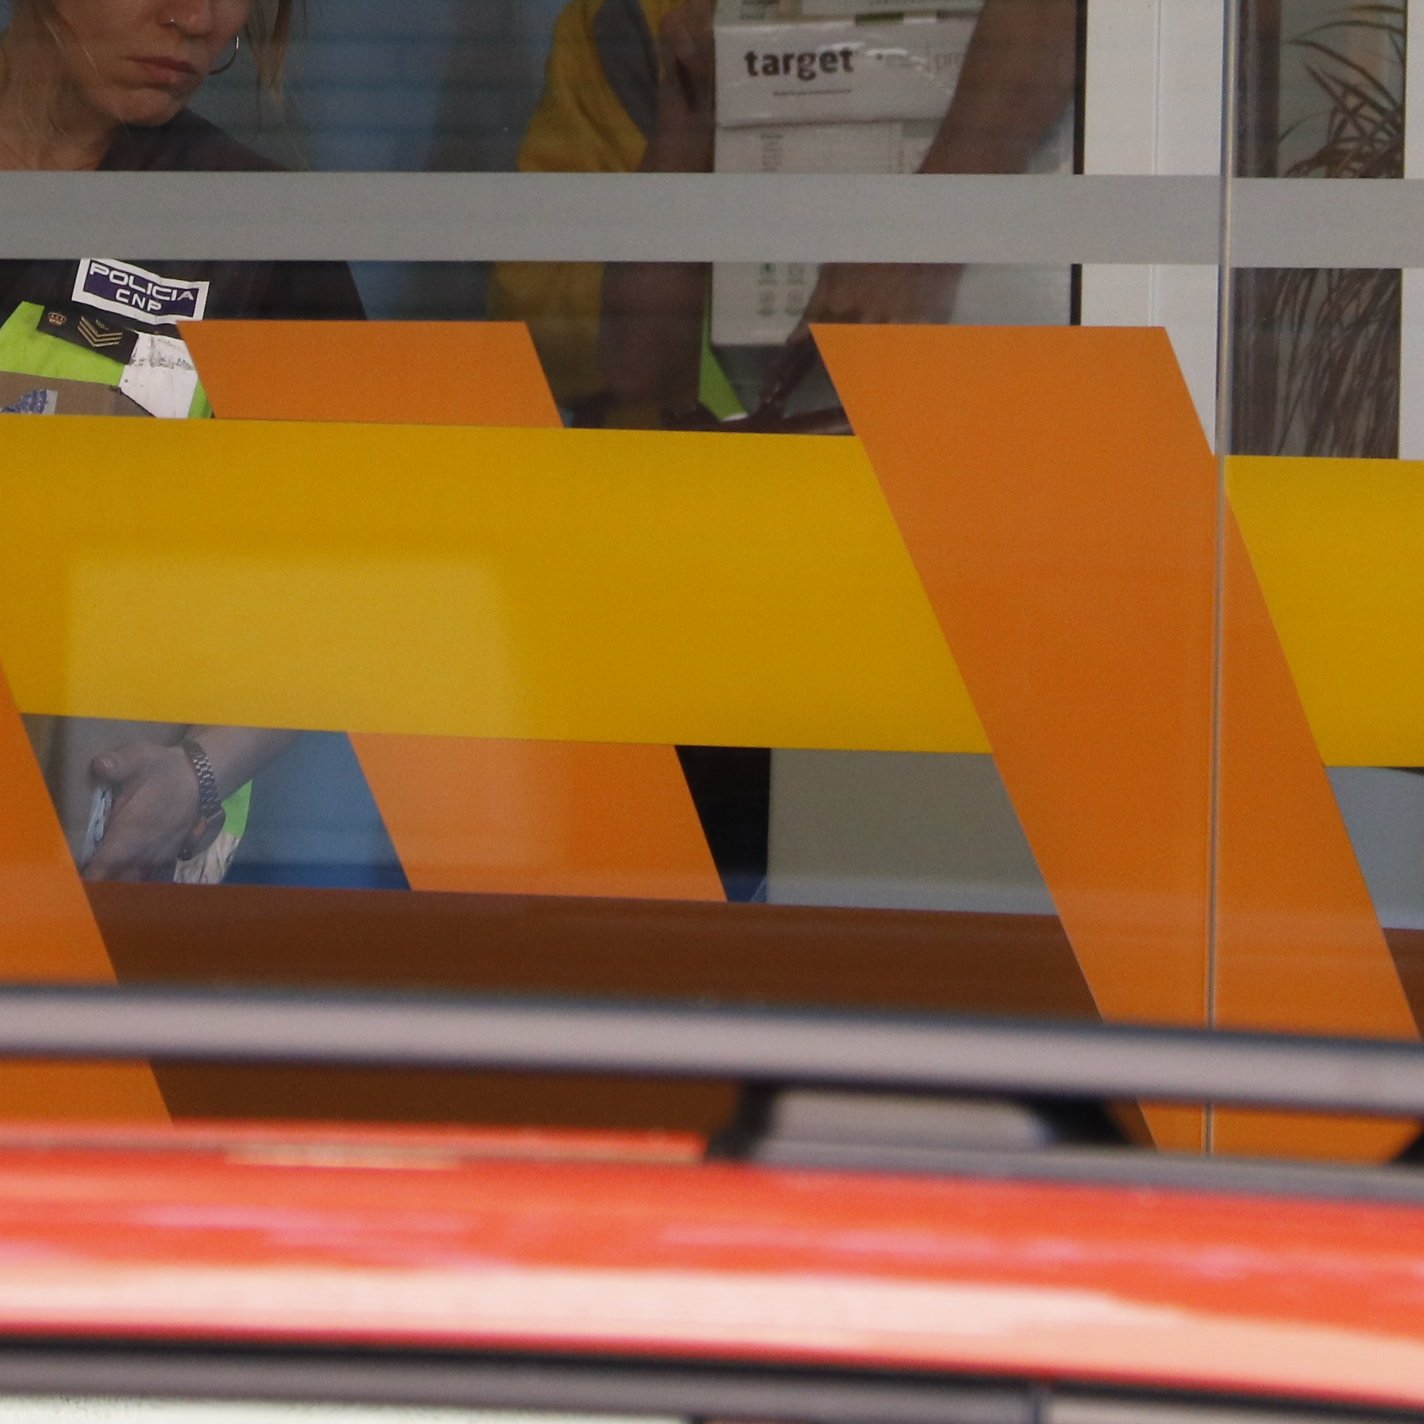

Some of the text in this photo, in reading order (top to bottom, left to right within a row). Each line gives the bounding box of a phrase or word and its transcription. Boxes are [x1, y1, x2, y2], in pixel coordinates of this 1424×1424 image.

[744, 47, 854, 81] target
[90, 262, 194, 301] POLICIA
[116, 289, 162, 312] CNP
